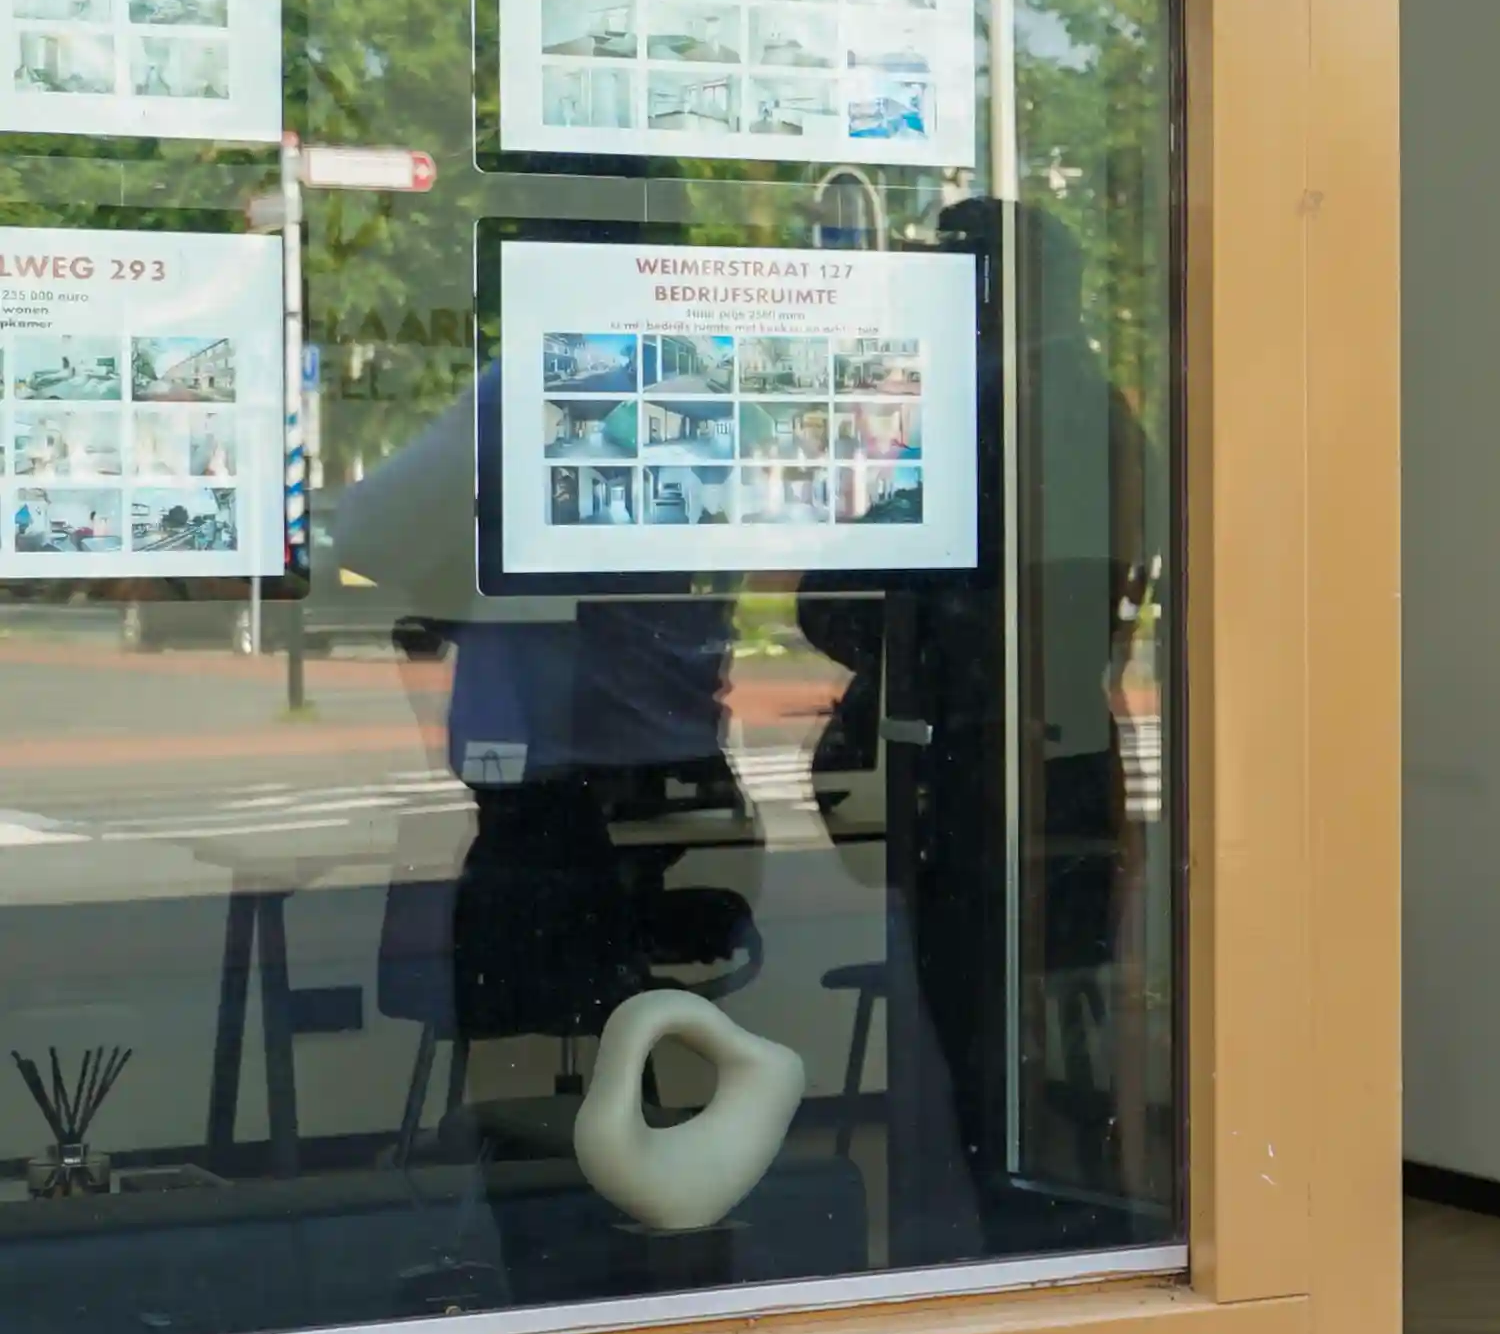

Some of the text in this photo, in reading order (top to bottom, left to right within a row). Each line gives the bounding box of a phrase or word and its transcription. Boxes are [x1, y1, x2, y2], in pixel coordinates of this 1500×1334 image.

[110, 259, 167, 282] 293
[635, 257, 855, 279] WEIMERSTRAAT 127
[655, 285, 838, 305] BEDRIJFSRUIMTE
